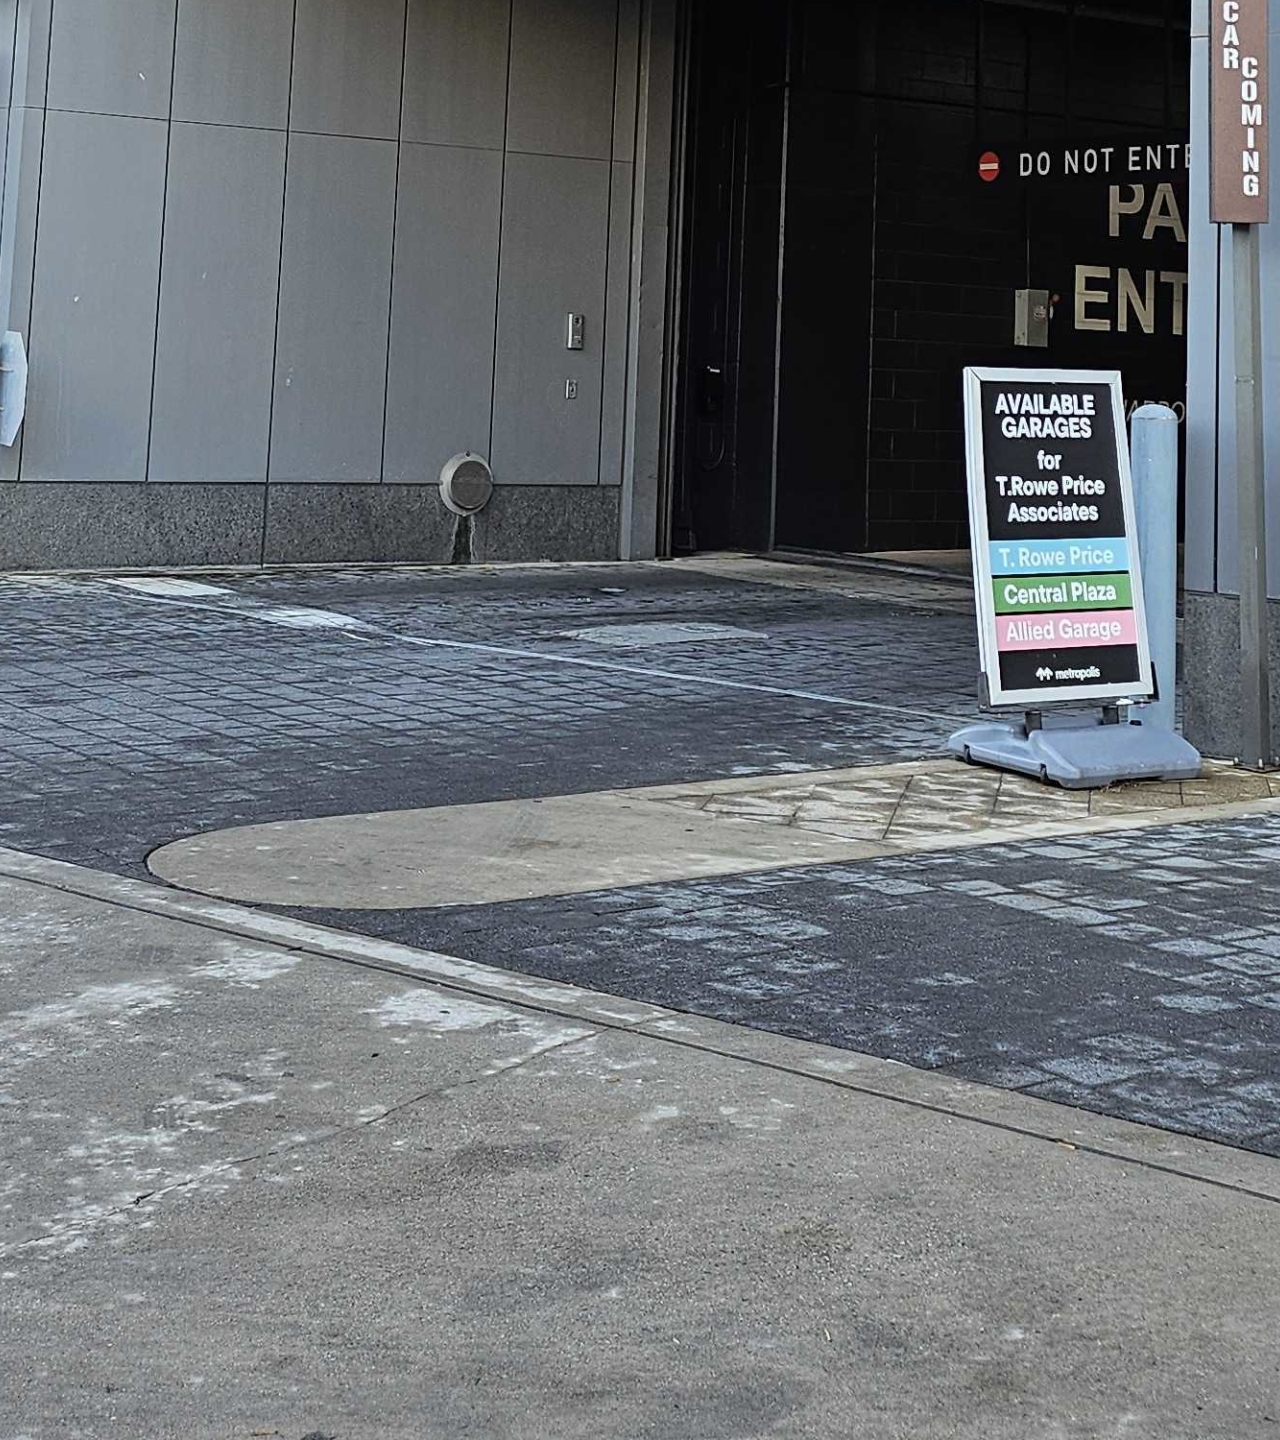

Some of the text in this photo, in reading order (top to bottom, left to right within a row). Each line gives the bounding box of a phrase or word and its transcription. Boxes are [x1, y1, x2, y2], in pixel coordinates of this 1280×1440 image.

[1222, 0, 1240, 69] CAR
[1241, 56, 1262, 197] COMING
[1020, 151, 1051, 177] DO
[1064, 147, 1114, 175] NOT
[1108, 183, 1187, 243] PA
[1074, 264, 1188, 336] ENT
[995, 393, 1096, 416] AVAILABLE
[1001, 416, 1092, 438] GARAGES
[1037, 449, 1062, 470] for
[995, 474, 1106, 496] T.Rowe Price
[1008, 501, 1099, 523] Associates
[998, 545, 1114, 568] T. Rowe Price
[1004, 581, 1117, 605] Central Plaza
[1006, 619, 1121, 641] Allied Garage
[1055, 666, 1101, 681] metropolis
